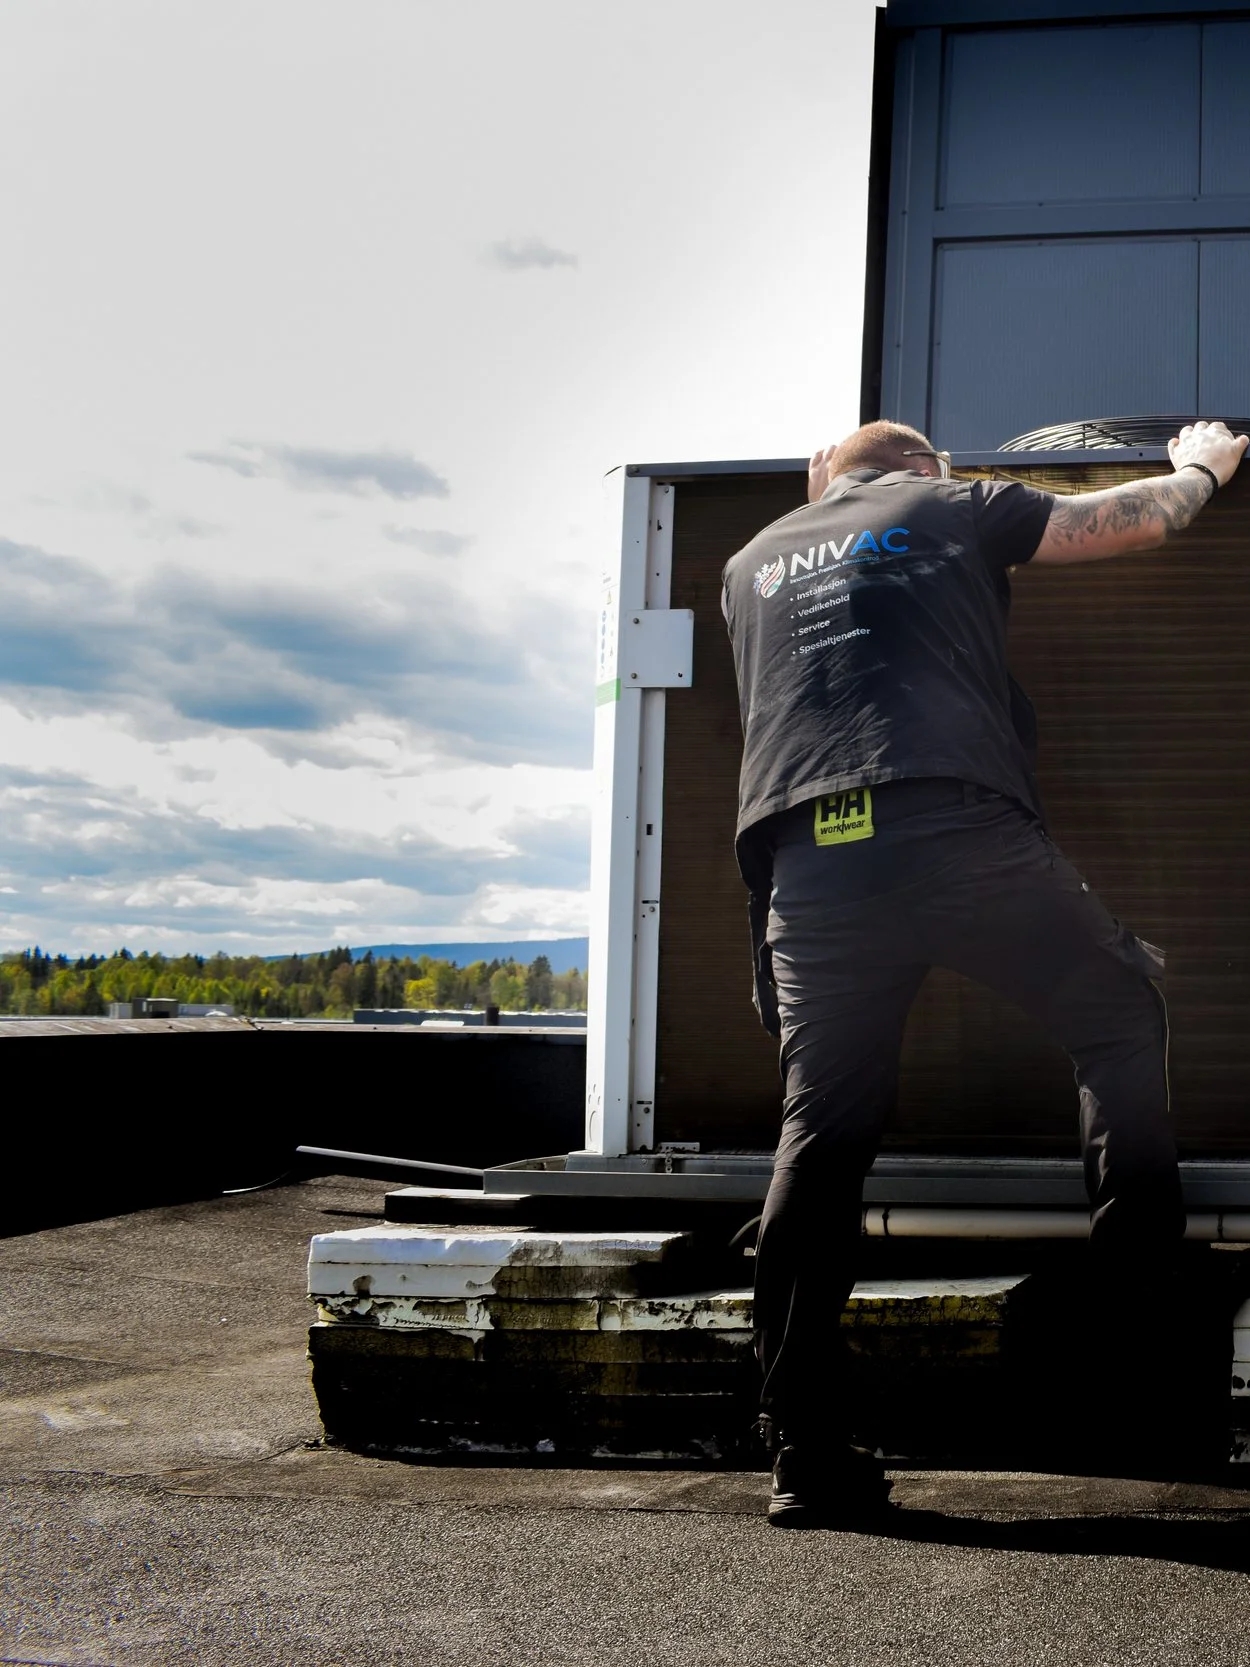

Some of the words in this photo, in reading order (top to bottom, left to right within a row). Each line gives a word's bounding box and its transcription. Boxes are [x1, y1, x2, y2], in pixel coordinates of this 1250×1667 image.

[790, 528, 910, 576] NIVAC
[796, 578, 846, 601] Installasjon
[798, 594, 850, 617] Vedlikehold
[798, 620, 831, 636] Service
[799, 628, 871, 654] Spesialtjenester
